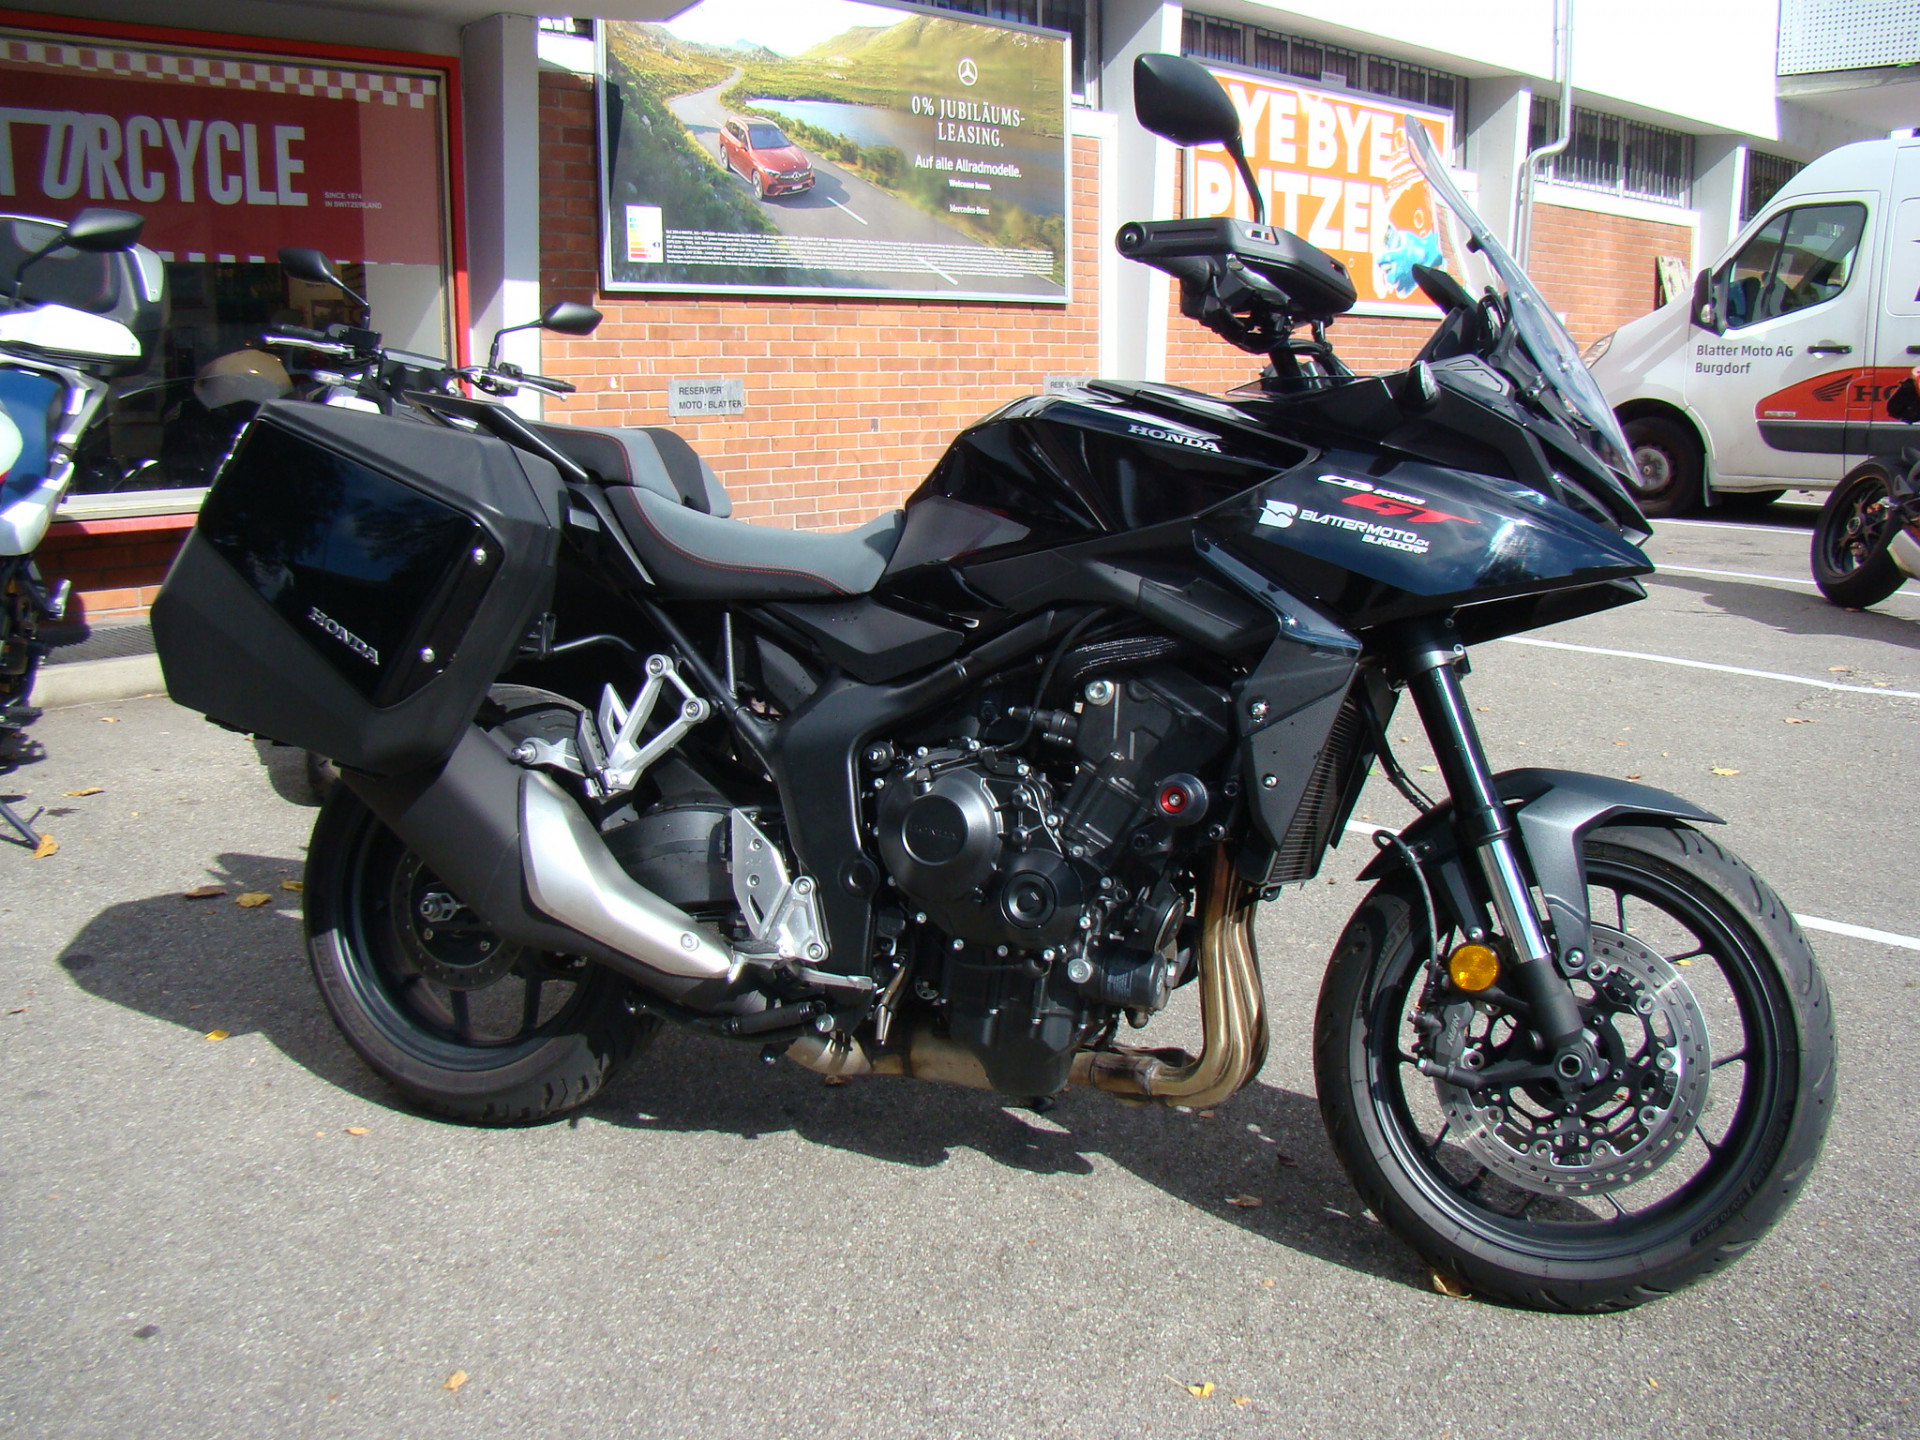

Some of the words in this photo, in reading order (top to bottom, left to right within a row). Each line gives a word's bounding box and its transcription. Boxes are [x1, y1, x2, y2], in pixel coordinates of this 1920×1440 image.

[911, 95, 935, 116] 0%
[939, 98, 1026, 128] JUBILÄUMS-
[937, 121, 1005, 148] LEASING.
[1197, 83, 1298, 165] YE
[1306, 96, 1395, 181] BYE
[914, 154, 934, 169] Auf
[935, 157, 954, 171] alle
[955, 157, 1023, 178] Allradmodelle.
[324, 191, 346, 200] SINCE
[325, 200, 333, 208] IN
[333, 201, 383, 209] SWITZERLAND
[949, 203, 990, 216] Mercedes-Benz
[1696, 344, 1737, 357] Blatter
[1740, 345, 1773, 357] Moto
[1775, 346, 1794, 358] AG
[1694, 361, 1751, 376] Burgdorf
[678, 386, 724, 396] RESERVIER
[678, 400, 703, 409] MOTO
[708, 400, 742, 409] BLATTER
[1127, 424, 1222, 454] HONDA
[1361, 533, 1429, 554] BURGDORF
[308, 606, 380, 666] HONDA
